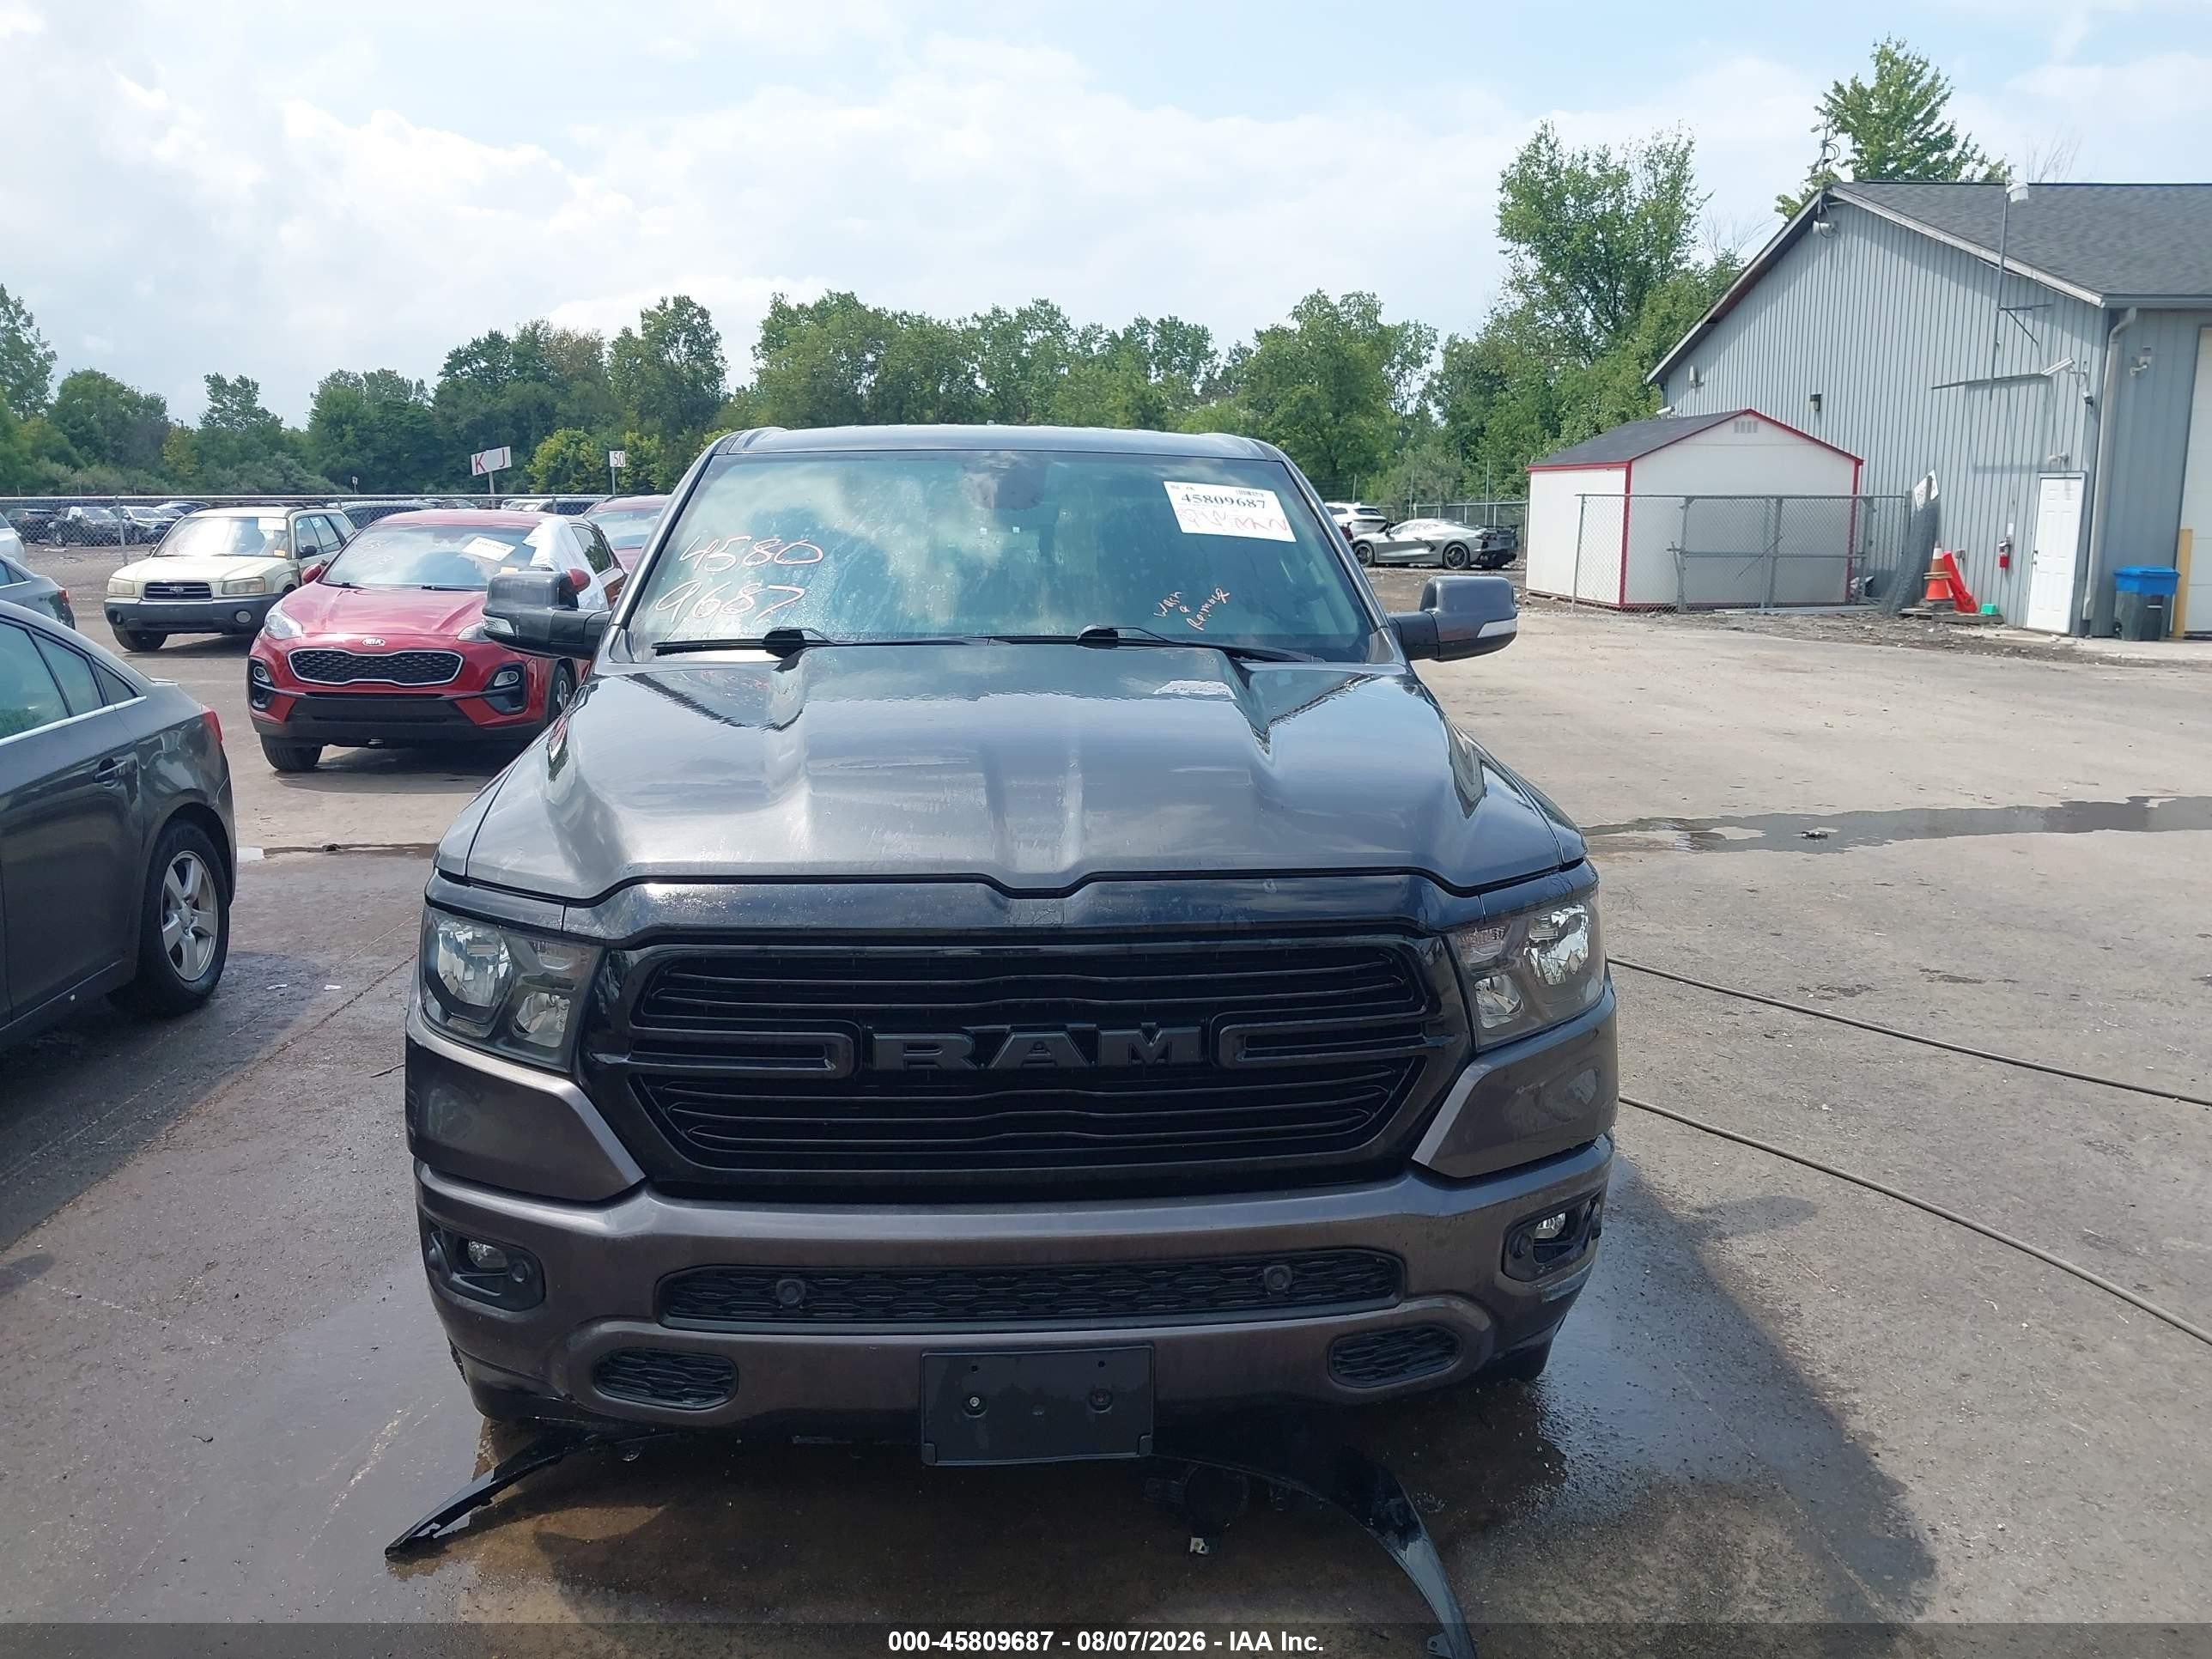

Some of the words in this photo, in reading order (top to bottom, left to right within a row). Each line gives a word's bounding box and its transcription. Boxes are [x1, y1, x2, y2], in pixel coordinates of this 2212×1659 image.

[474, 453, 486, 474] K
[498, 447, 507, 468] J
[613, 452, 625, 467] 50
[1181, 493, 1267, 509] 45809687
[678, 534, 824, 573] 4580
[655, 580, 805, 624] 9687
[872, 1024, 1202, 1070] RAM
